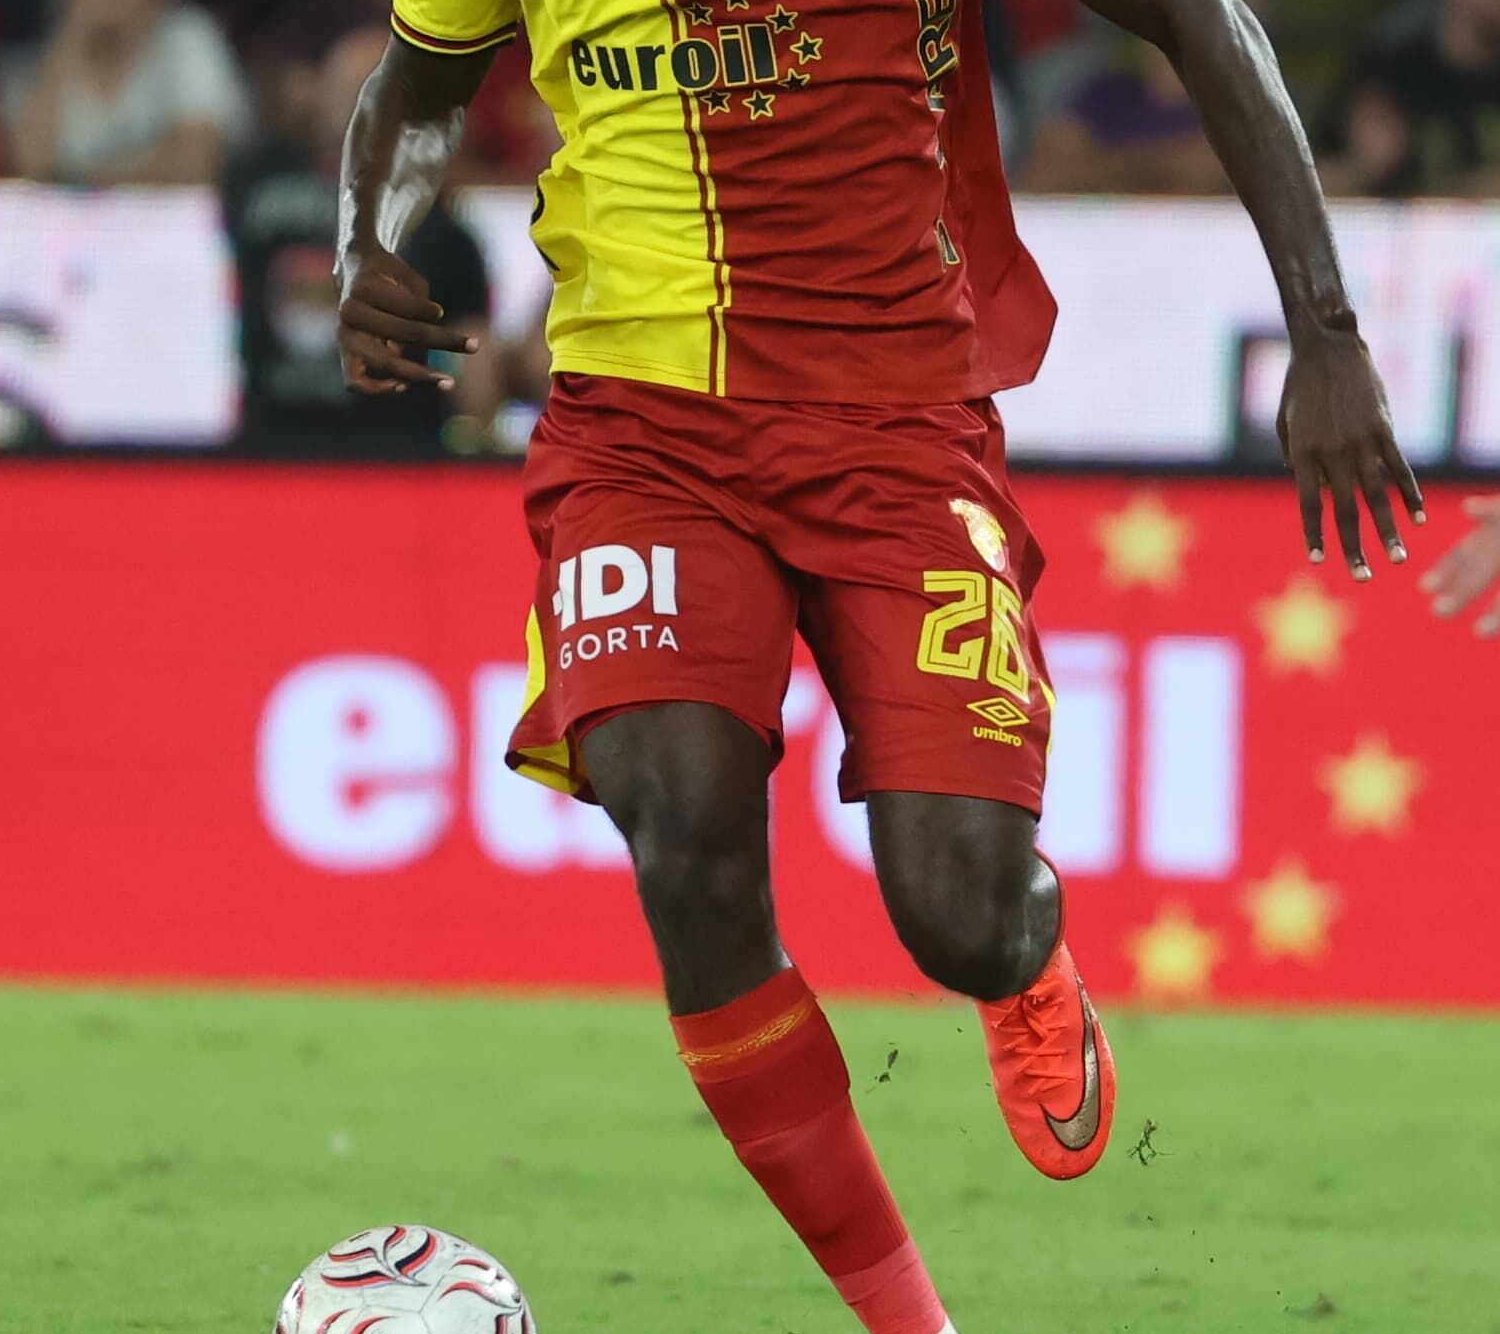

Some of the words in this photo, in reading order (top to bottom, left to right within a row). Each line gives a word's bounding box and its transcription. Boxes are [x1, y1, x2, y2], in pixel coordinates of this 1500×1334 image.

[571, 23, 779, 92] euroil
[916, 570, 1031, 704] 26
[973, 726, 1023, 747] umbro
